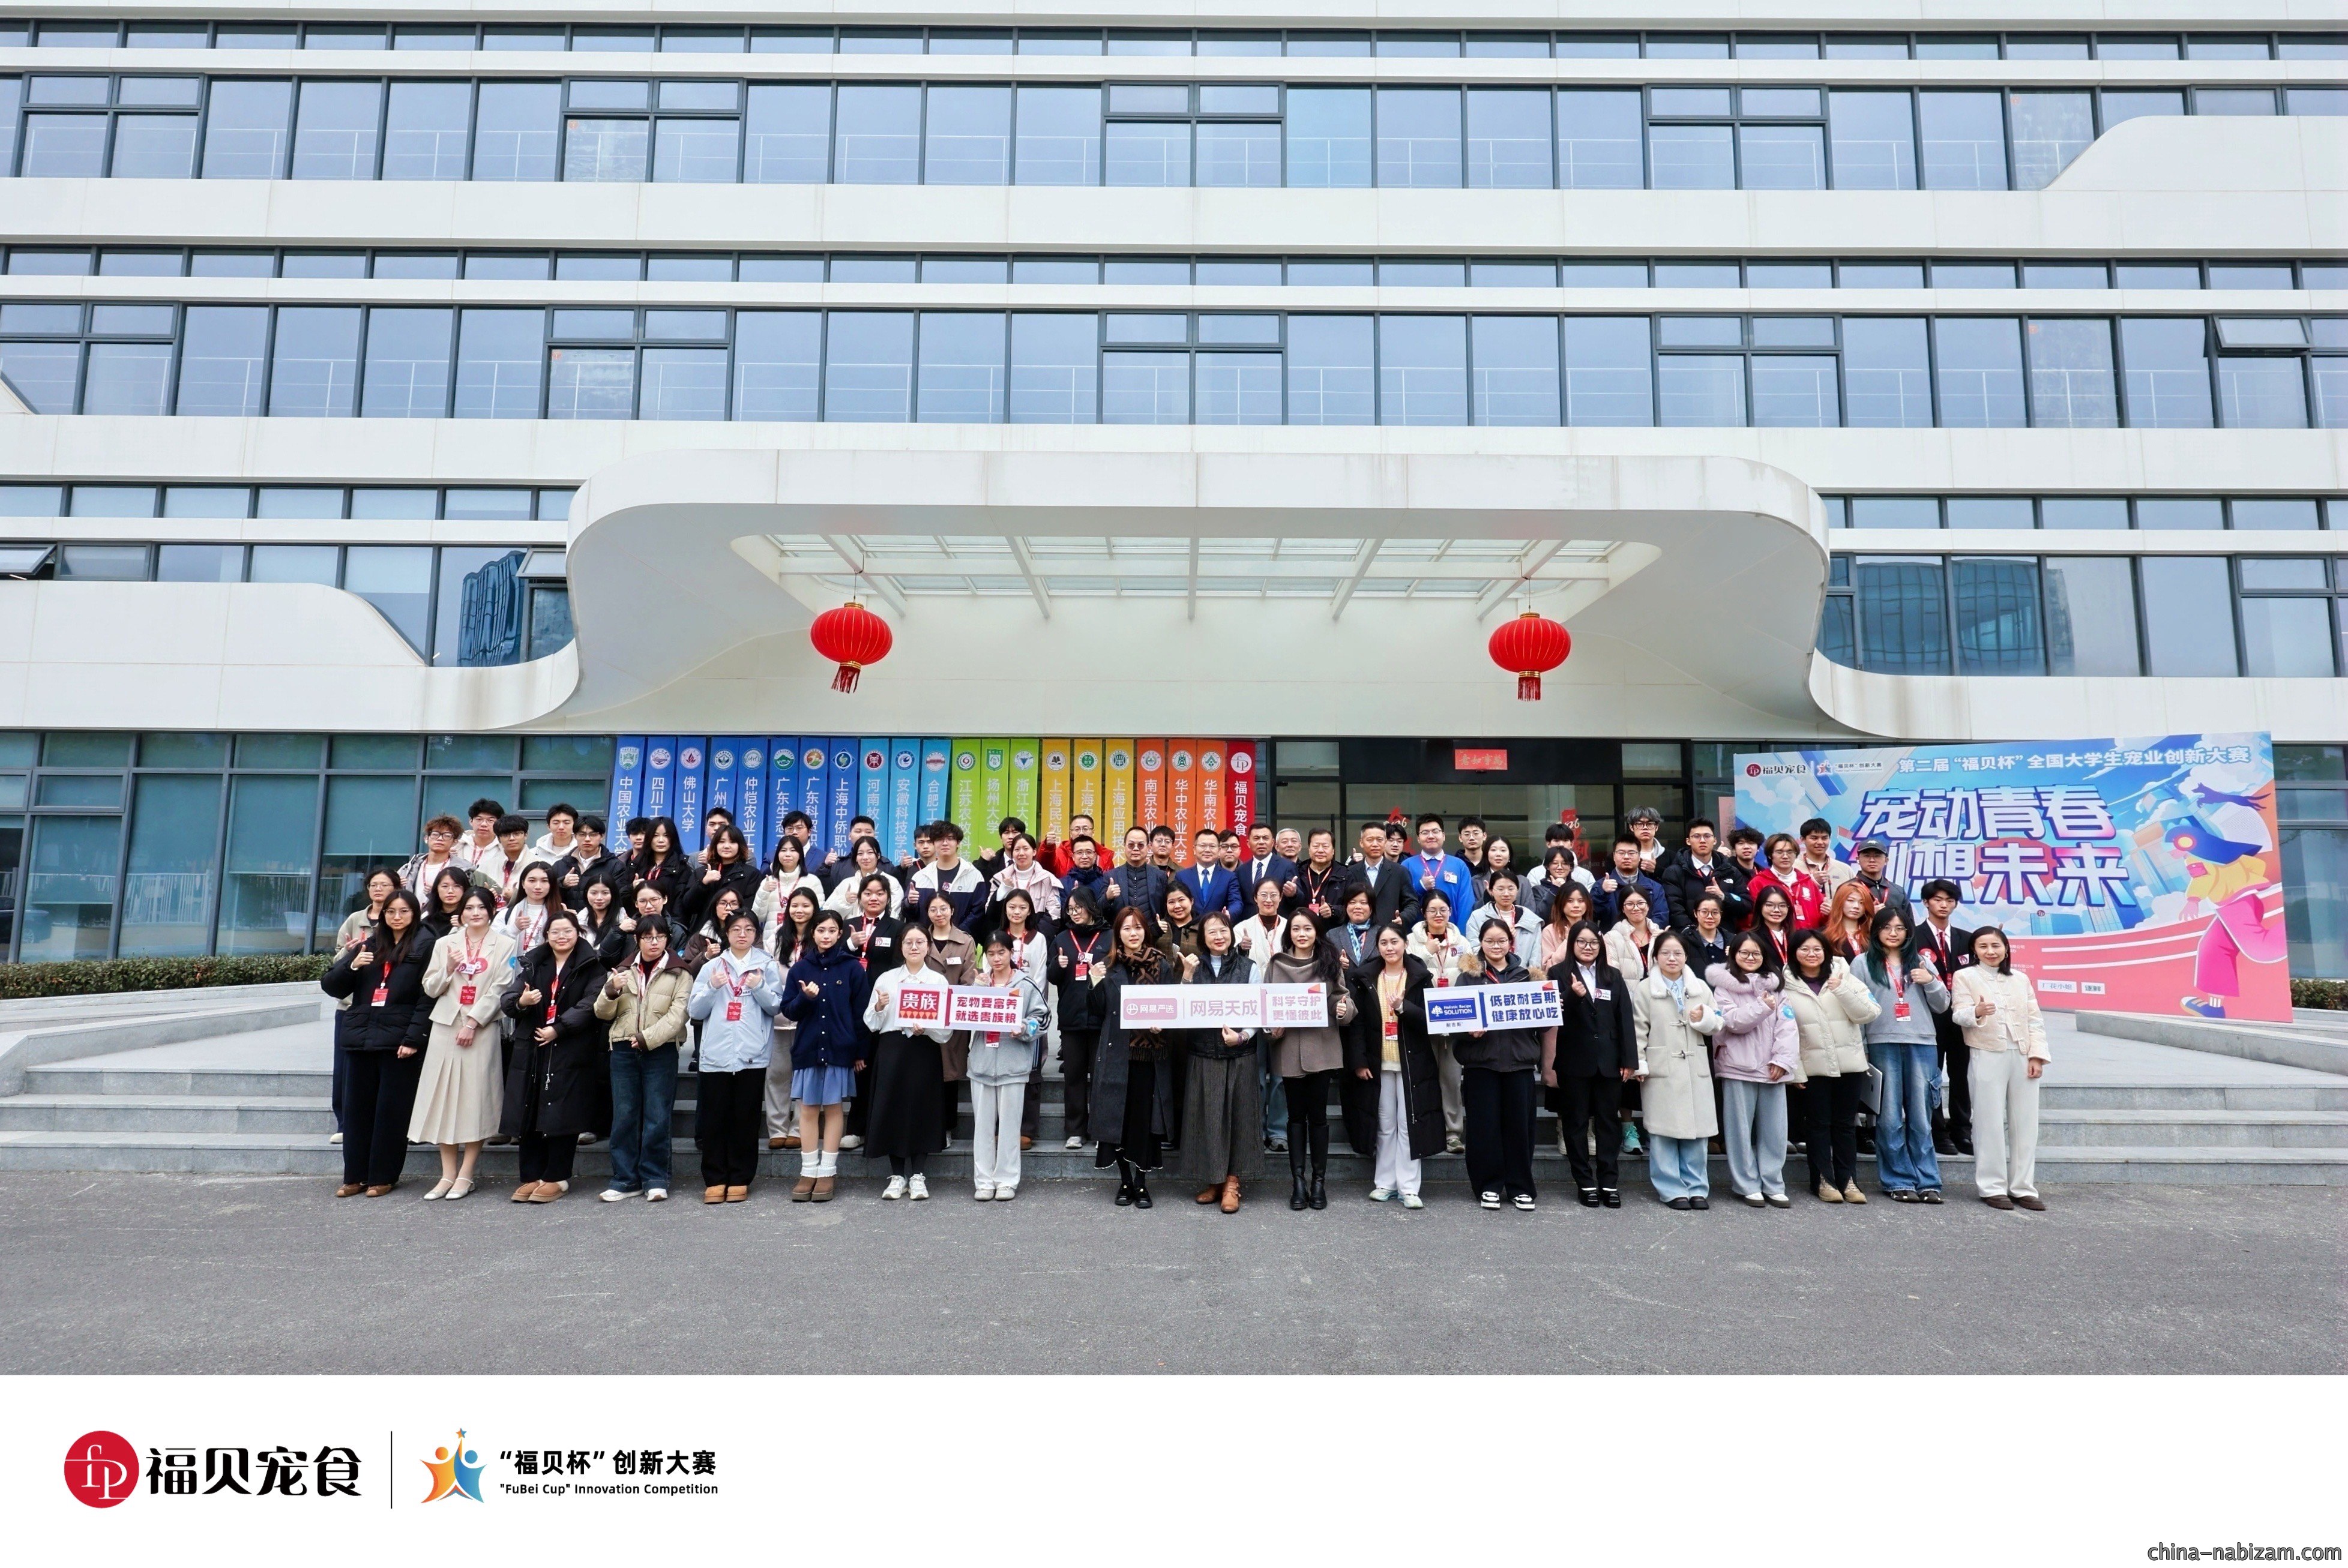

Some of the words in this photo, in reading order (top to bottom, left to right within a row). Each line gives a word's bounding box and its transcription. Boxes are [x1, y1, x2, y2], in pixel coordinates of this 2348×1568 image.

[1899, 758, 1949, 772] 第二届
[2027, 746, 2250, 769] 全国大学生宠业创新大赛
[1763, 764, 1806, 775] 福贝宠食
[714, 778, 728, 809] 广州
[927, 780, 939, 825] 合肥工
[681, 776, 696, 832] 佛山大学
[987, 778, 999, 834] 扬州大学
[1234, 781, 1247, 837] 福贝宠食
[1855, 784, 2116, 840] 宠动青春
[1112, 778, 1125, 867] 上海应用技术
[1175, 779, 1188, 863] 华中农业大学
[902, 993, 938, 1011] 贵族
[956, 996, 1017, 1009] 宠物要富养
[1272, 996, 1322, 1007] 科学守护
[1490, 991, 1556, 1007] 低敏耐吉斯
[955, 1010, 1016, 1024] 就选贵族粮
[1140, 1004, 1175, 1014] 网易严选
[1190, 1000, 1258, 1017] 网易天成
[1272, 1010, 1322, 1021] 更懂彼此
[1492, 1007, 1558, 1022] 健康放心吃
